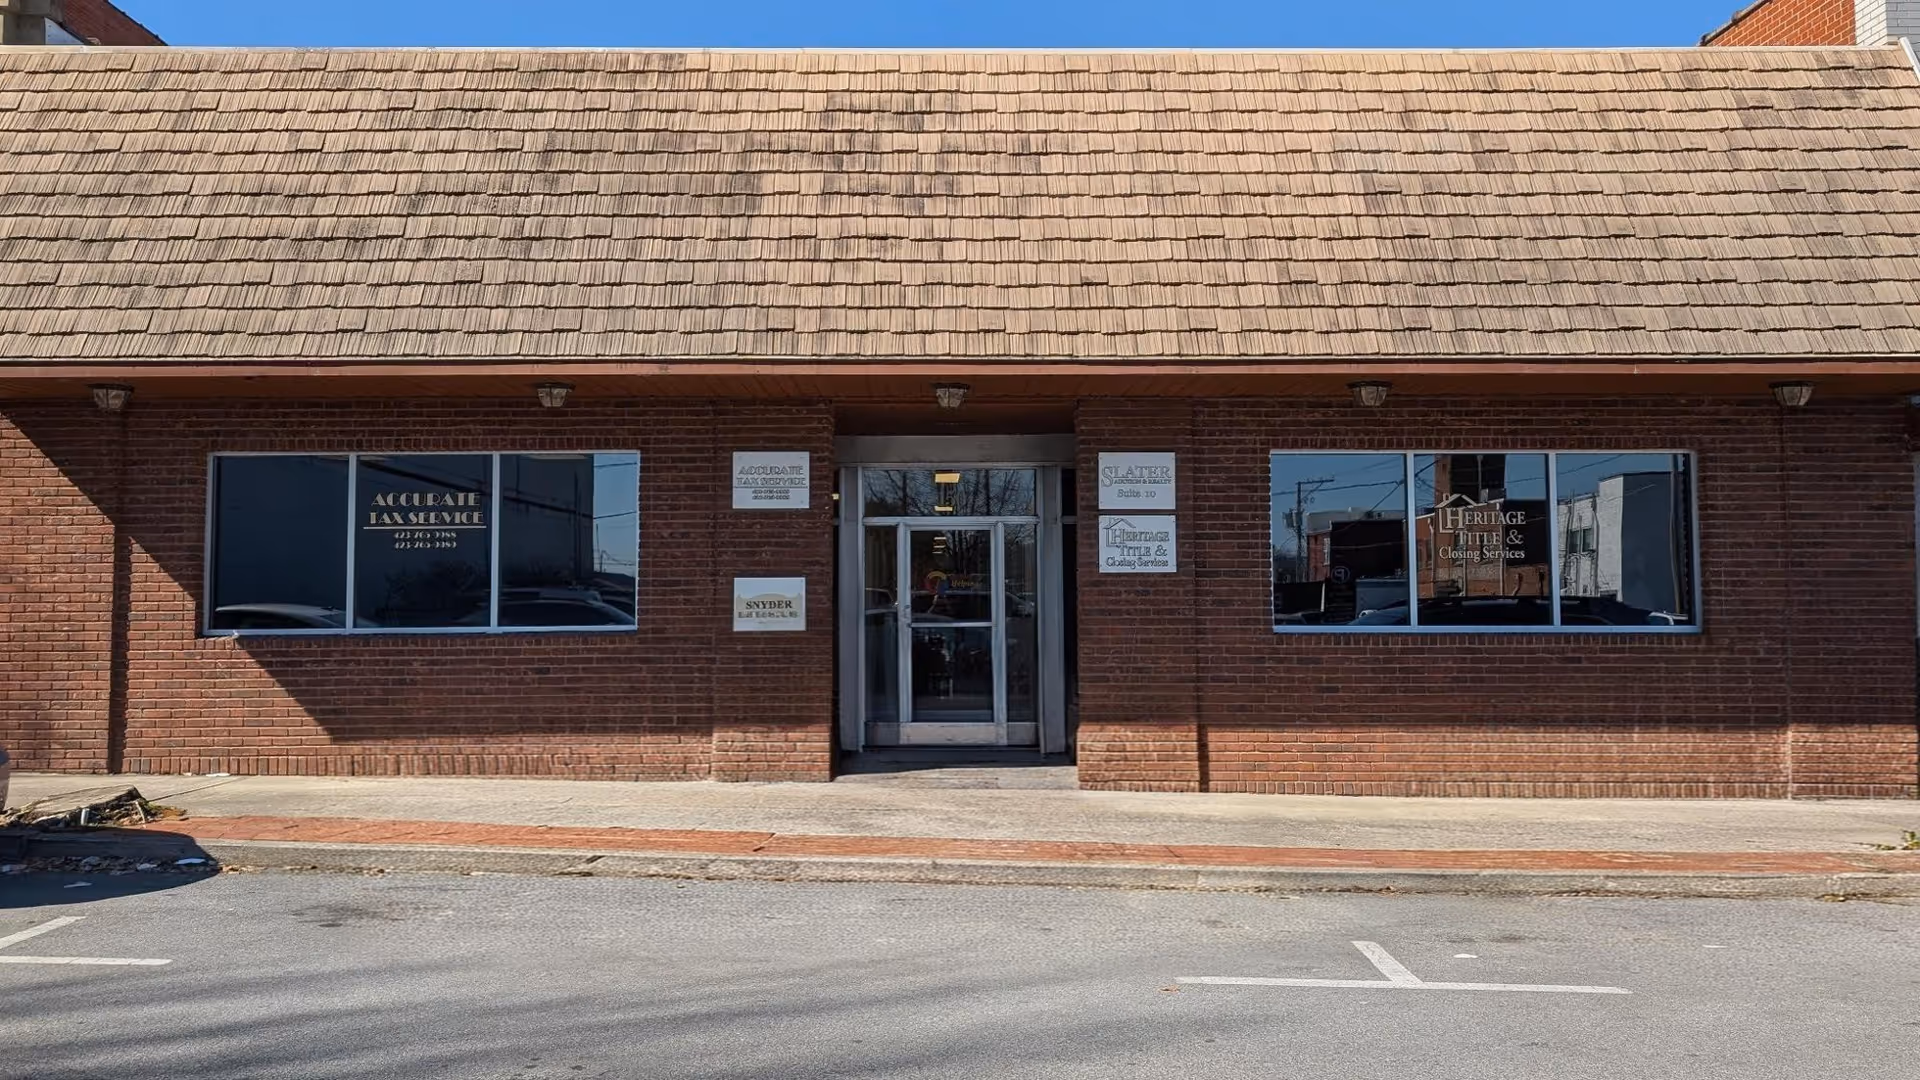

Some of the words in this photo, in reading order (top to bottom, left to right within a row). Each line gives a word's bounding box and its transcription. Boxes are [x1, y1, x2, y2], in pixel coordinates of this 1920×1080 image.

[737, 465, 804, 475] ACCURATE
[1101, 465, 1171, 487] SLATER
[736, 477, 759, 486] TAX
[760, 477, 806, 486] SERVICE
[371, 492, 480, 507] ACCURATE
[1117, 489, 1141, 498] Suite
[370, 512, 404, 524] TAX
[408, 511, 484, 524] SERVICE
[1445, 507, 1526, 529] HERITAGE
[1110, 529, 1169, 544] HERITAGE
[1456, 530, 1501, 545] TITLE
[1506, 529, 1524, 545] &
[1119, 545, 1151, 556] TITLE
[1155, 545, 1168, 556] &
[1440, 546, 1480, 563] Closing
[1483, 546, 1525, 559] Services
[1106, 557, 1137, 570] Closing
[1137, 557, 1169, 567] Services
[745, 600, 793, 610] SNYDER
